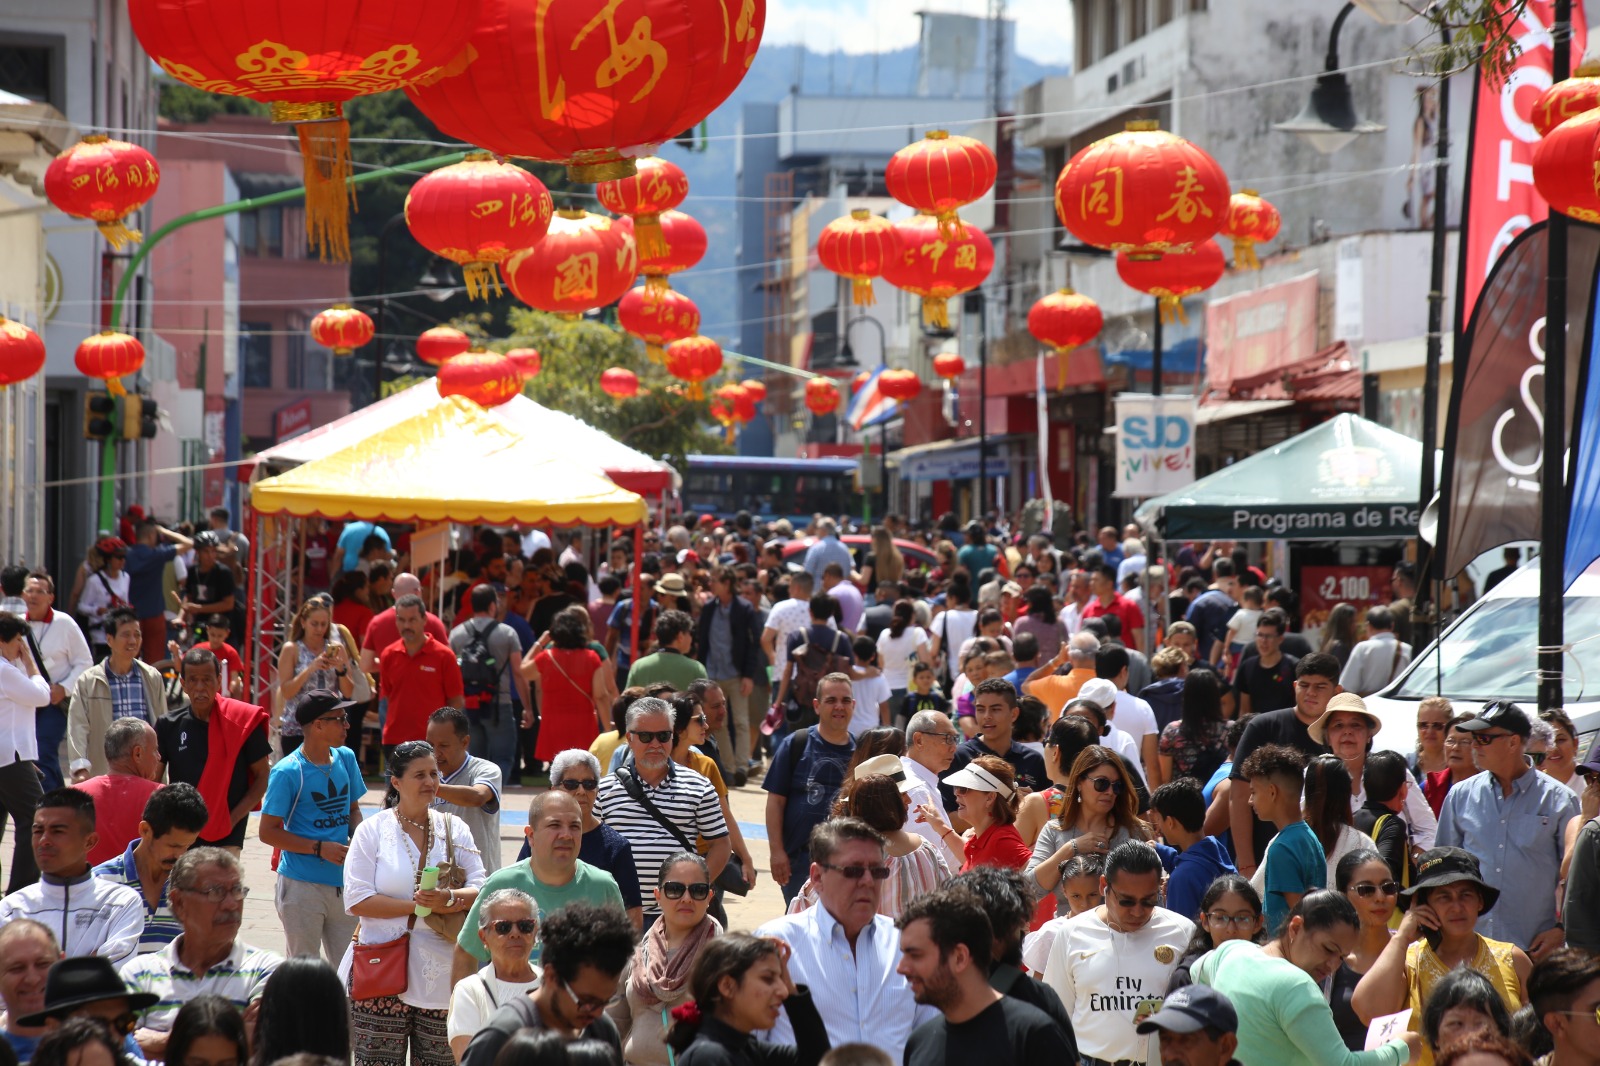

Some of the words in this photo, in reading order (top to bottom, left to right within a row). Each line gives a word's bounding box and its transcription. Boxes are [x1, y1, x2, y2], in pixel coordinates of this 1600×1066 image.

[1233, 509, 1346, 533] Programa
[1353, 506, 1382, 527] de
[313, 813, 351, 829] adidas
[1116, 976, 1142, 992] Fly
